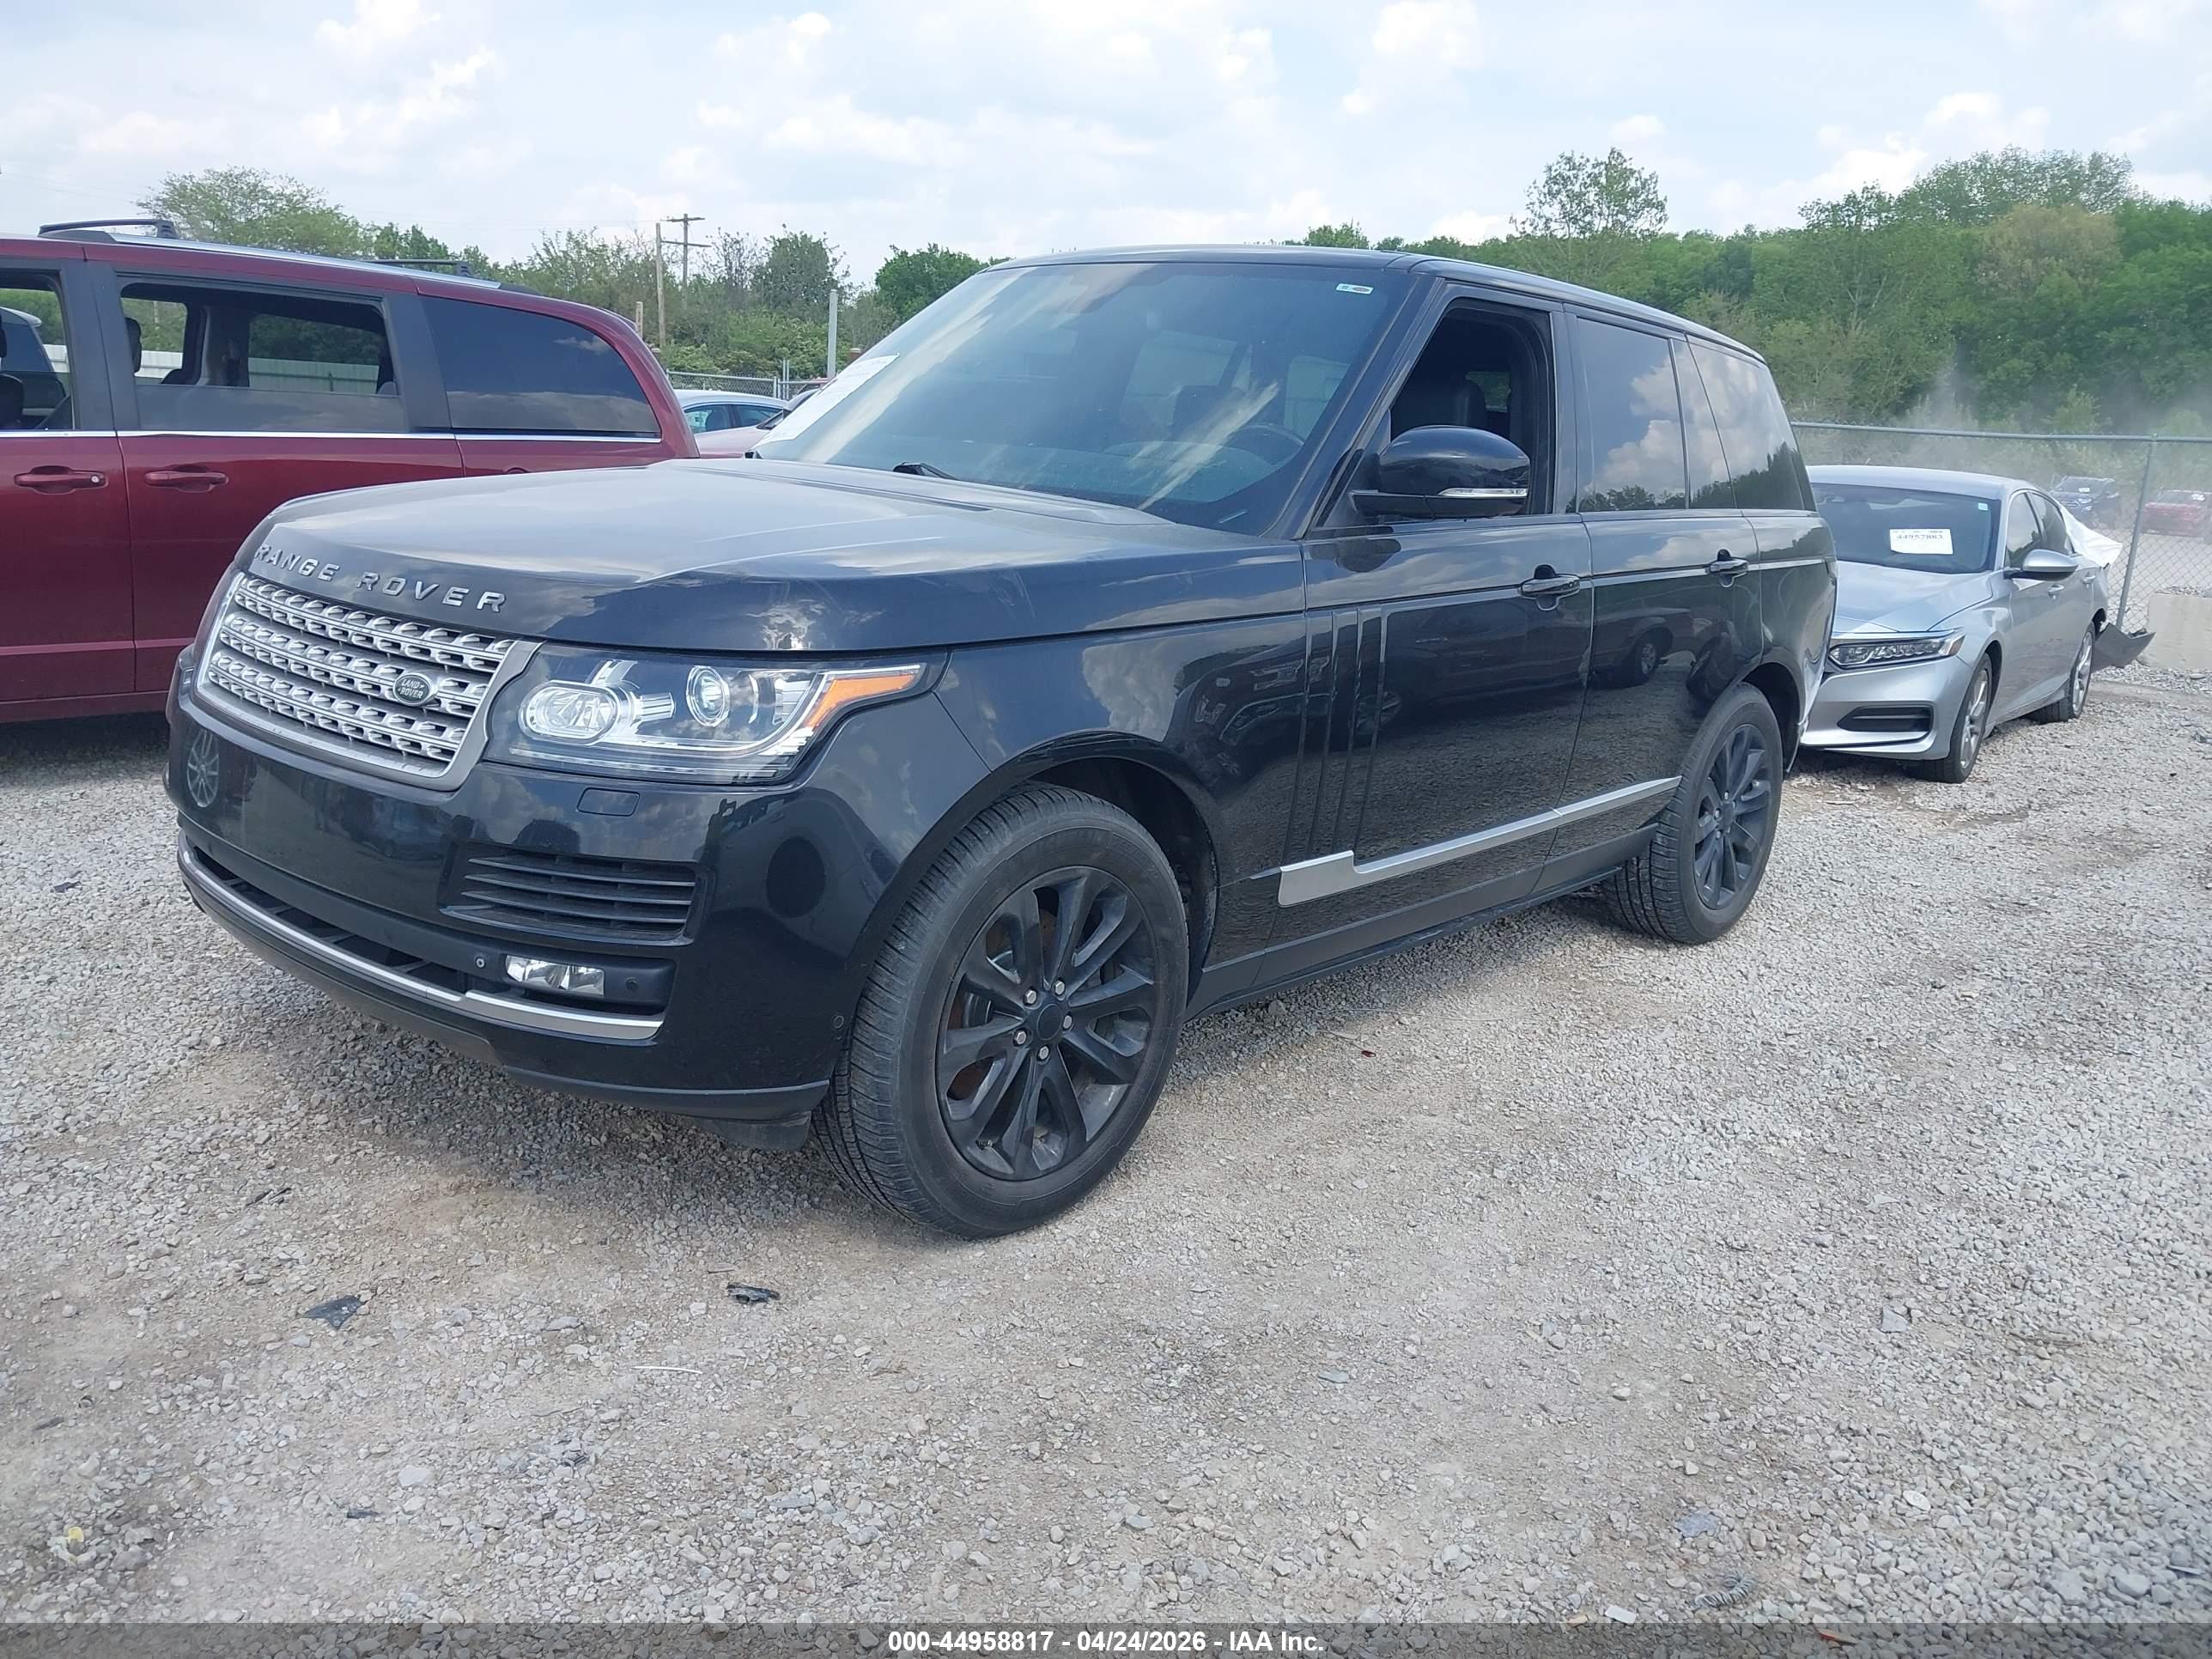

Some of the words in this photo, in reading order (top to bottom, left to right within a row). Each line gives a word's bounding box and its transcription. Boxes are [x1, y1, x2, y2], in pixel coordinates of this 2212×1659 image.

[254, 544, 340, 581] RANGE
[357, 571, 507, 612] ROVER
[401, 678, 421, 689] LAND
[399, 687, 423, 699] ROVER
